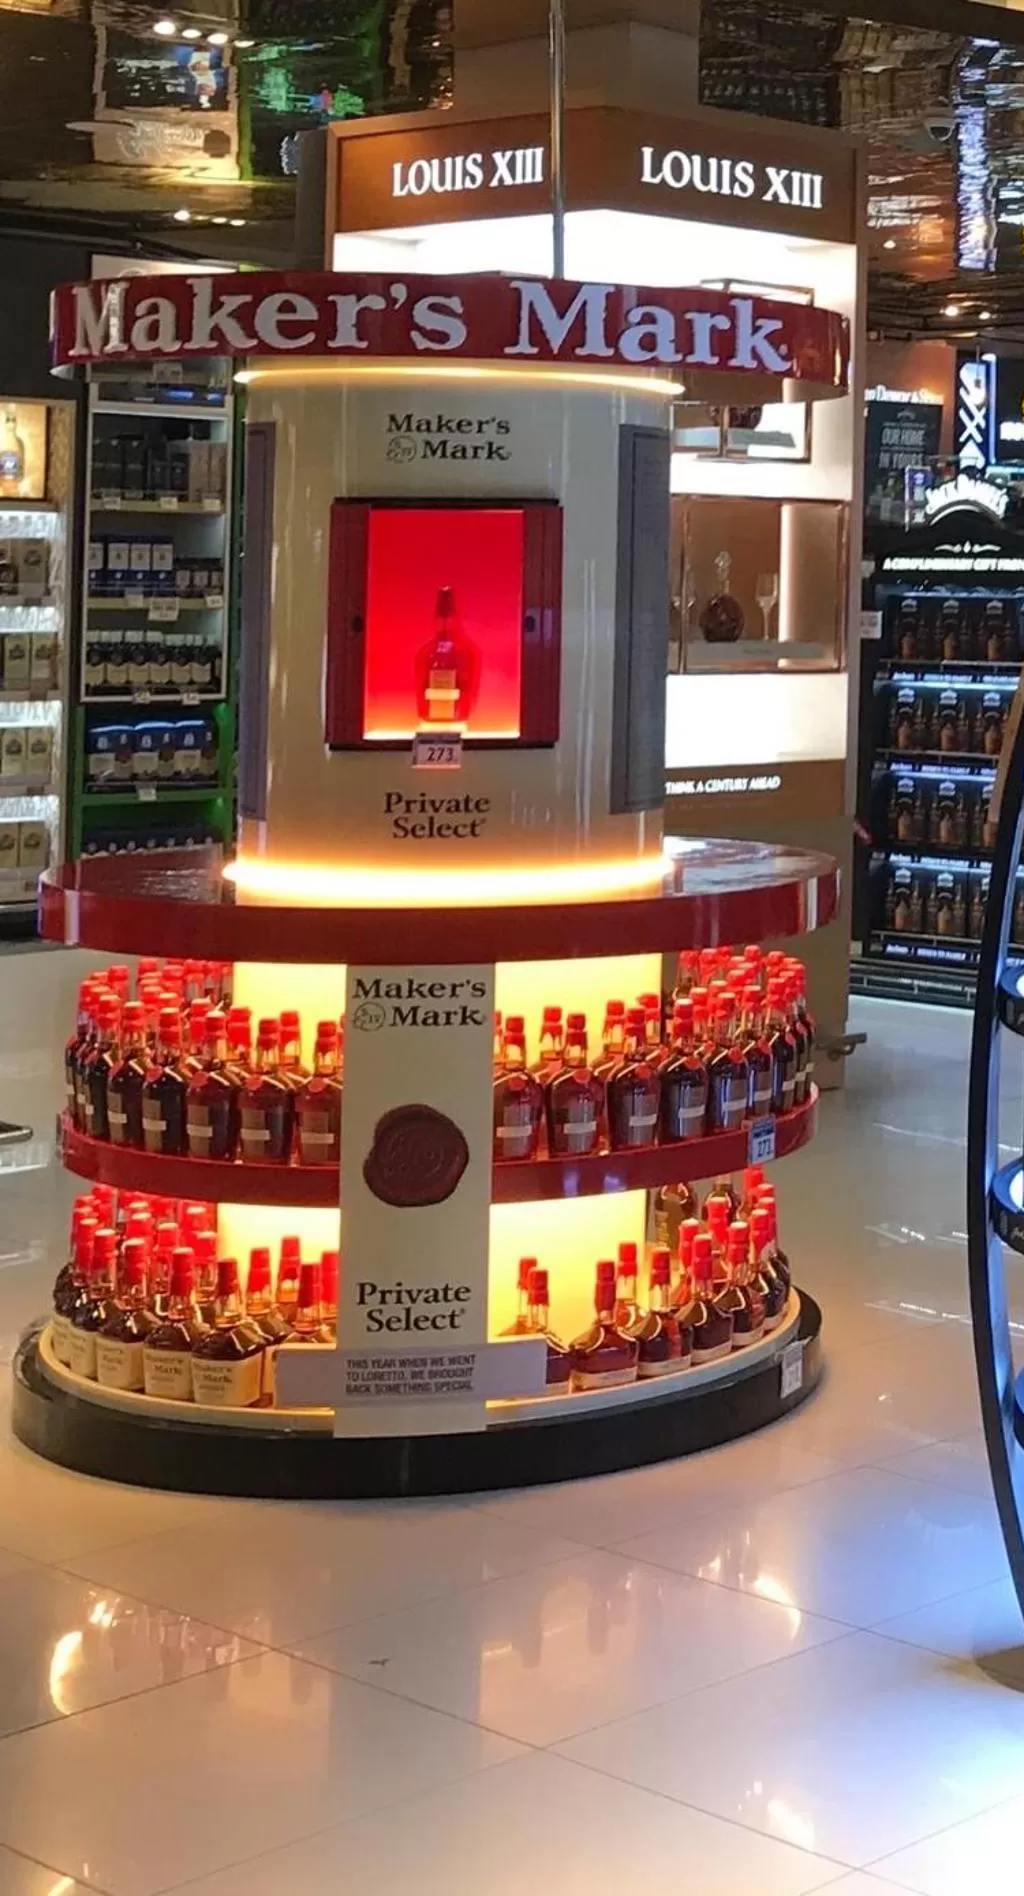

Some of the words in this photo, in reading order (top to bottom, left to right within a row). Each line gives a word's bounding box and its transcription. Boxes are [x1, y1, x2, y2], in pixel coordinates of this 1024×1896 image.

[393, 152, 485, 197] LOUIS
[489, 147, 545, 187] XIII
[641, 146, 755, 198] LOUIS
[762, 166, 824, 209] XIII
[67, 277, 468, 356] Maker's
[503, 281, 792, 373] Mark
[387, 413, 511, 435] Maker's
[420, 439, 509, 461] Mark
[427, 748, 454, 763] 273
[384, 791, 491, 814] Private
[393, 815, 482, 839] Select
[352, 978, 488, 999] Maker's
[389, 1005, 486, 1027] Mark
[356, 1281, 471, 1305] Private
[366, 1306, 460, 1332] Select
[347, 1359, 368, 1369] THIS
[371, 1359, 396, 1369] YEAR
[448, 1354, 476, 1366] WENT
[346, 1371, 360, 1382] TO
